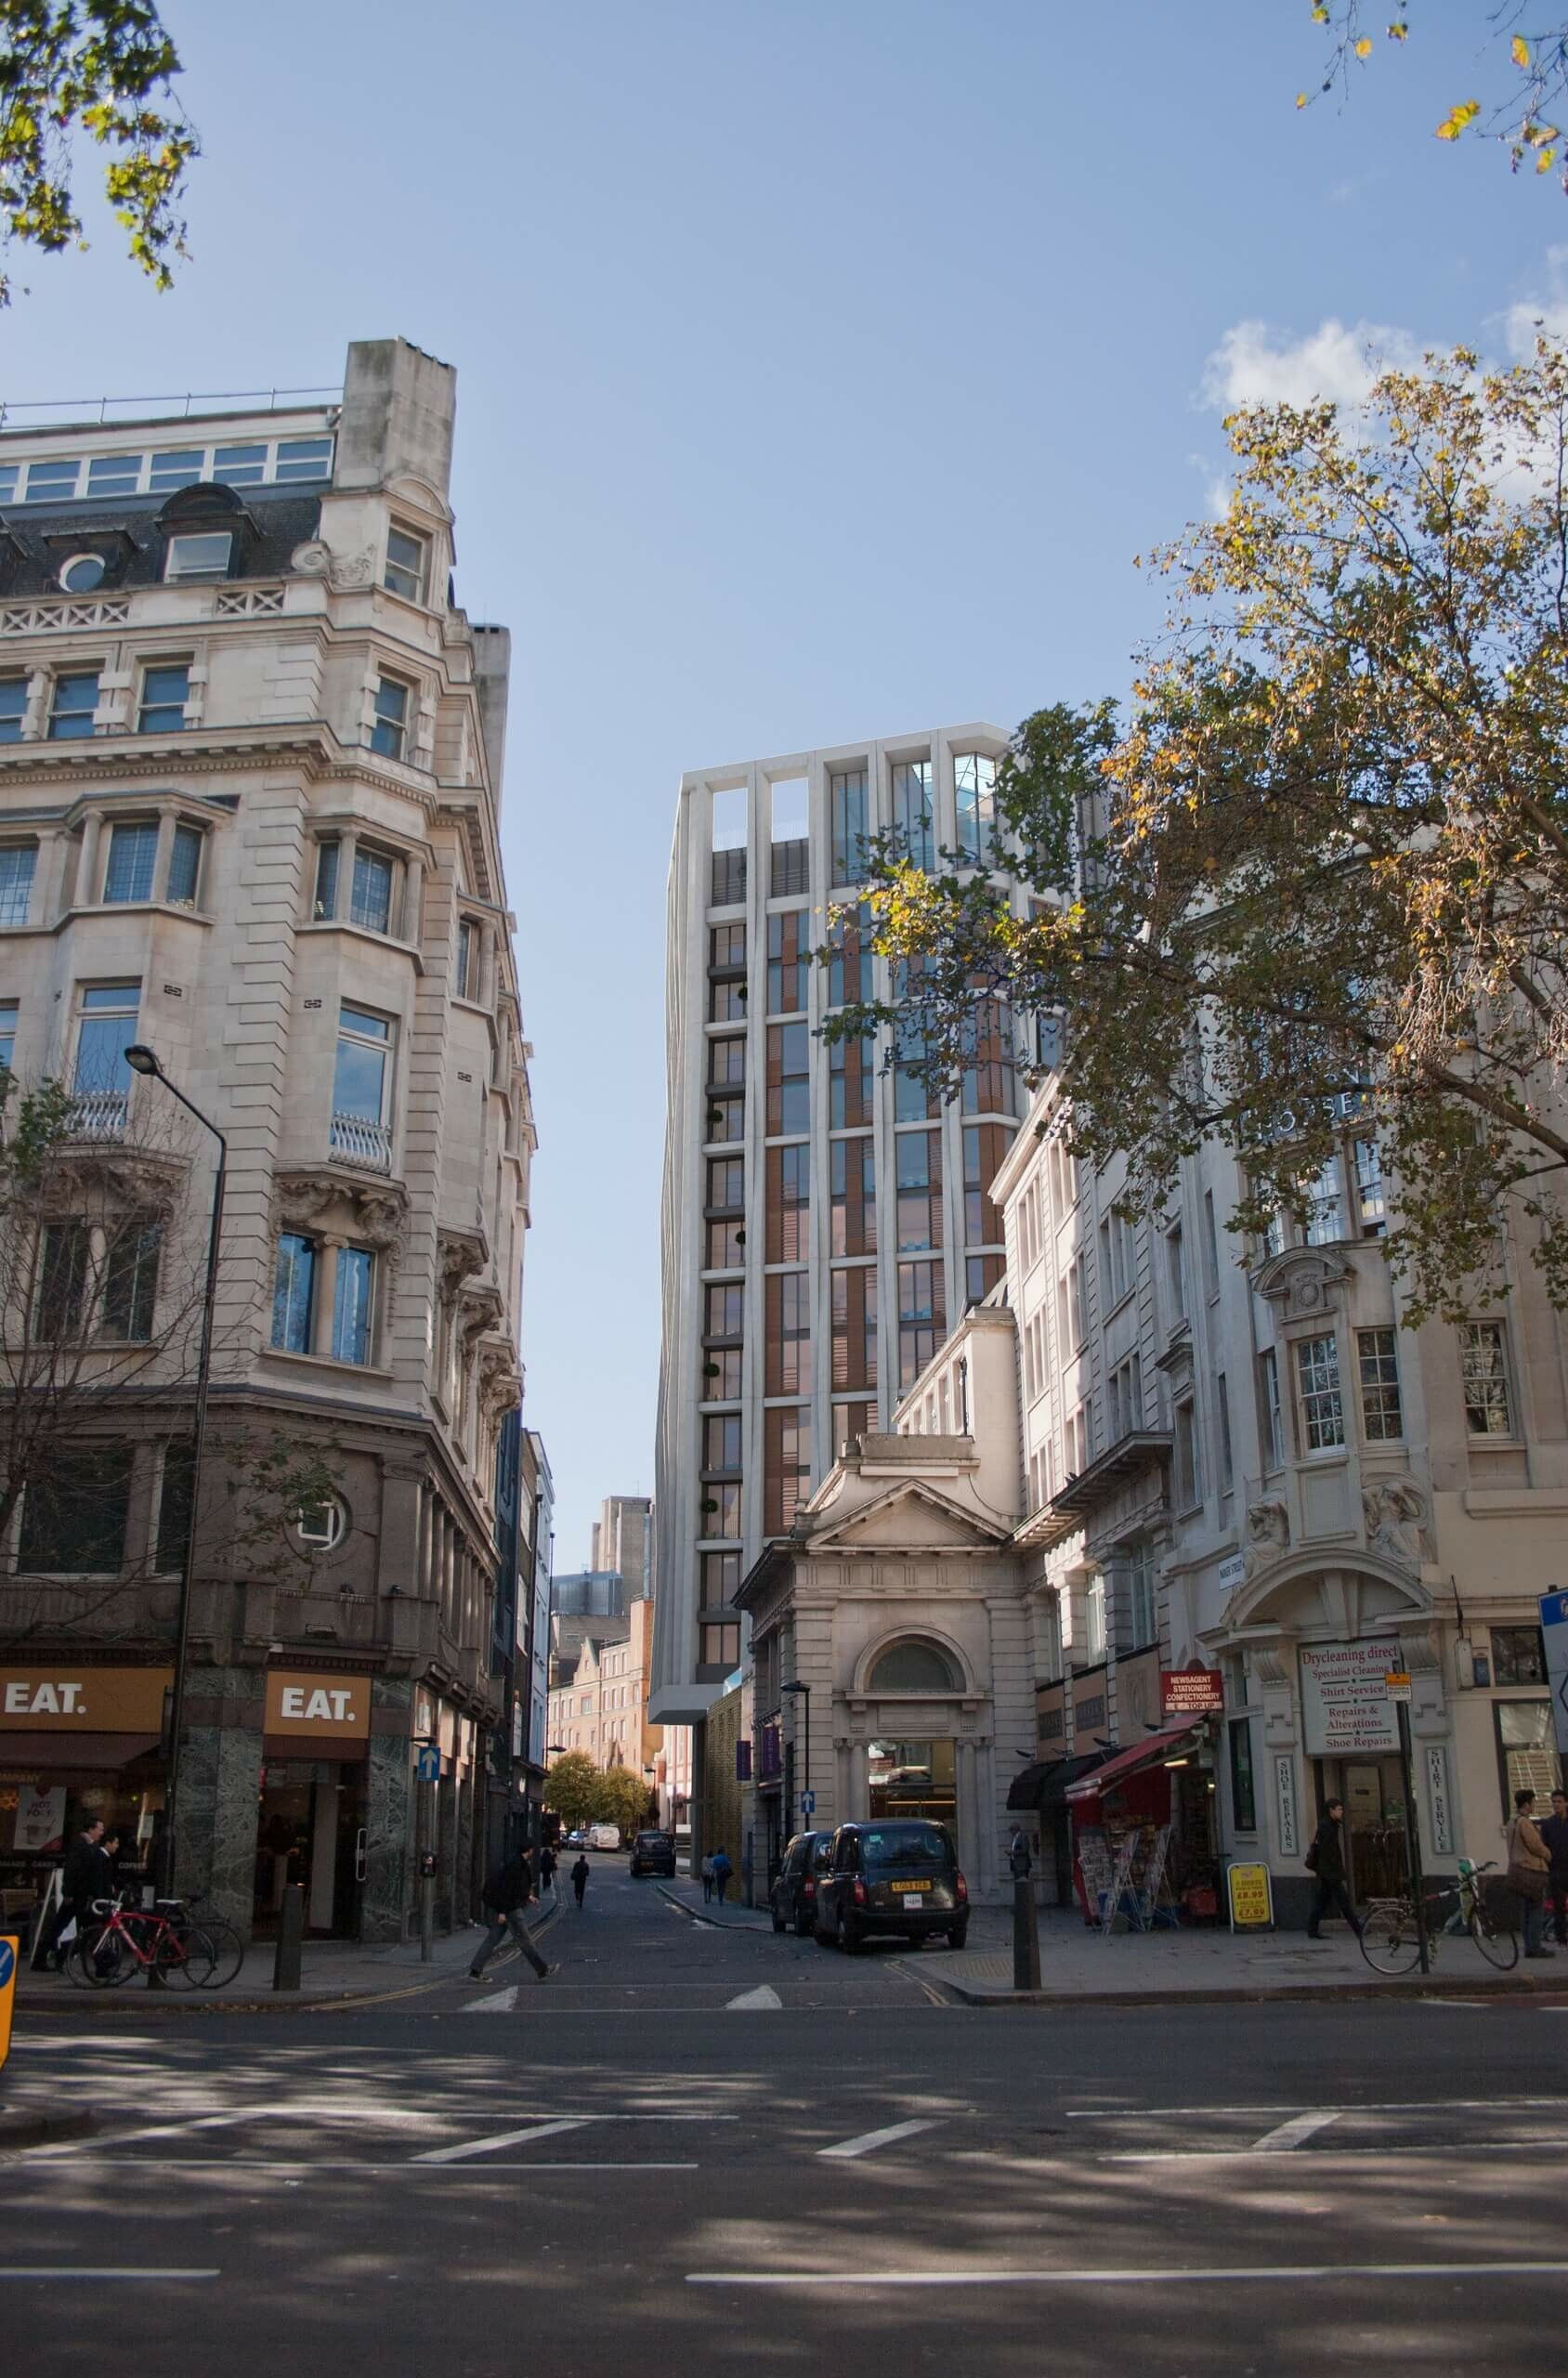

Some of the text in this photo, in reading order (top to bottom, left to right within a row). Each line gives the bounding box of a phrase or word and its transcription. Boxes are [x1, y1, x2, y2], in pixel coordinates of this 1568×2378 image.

[1302, 1644, 1398, 1666] Drycleaning direct
[1312, 1664, 1392, 1679] Specialist Cleaning
[1170, 1676, 1211, 1684] NEWSAGENT
[1172, 1684, 1212, 1692] STATIONERY
[1321, 1686, 1345, 1697] Shirt
[1347, 1684, 1384, 1696] Service
[4, 1682, 87, 1715] EAT.
[1166, 1692, 1220, 1702] CONFECTIONERY
[281, 1687, 356, 1722] EAT.
[1328, 1705, 1379, 1718] Repairs &
[1327, 1718, 1383, 1730] Alterations
[1326, 1737, 1392, 1749] Shoe Repairs
[1280, 1760, 1293, 1849] SHOE REPAIRS
[1431, 1749, 1447, 1850] SHIRT SERVICE
